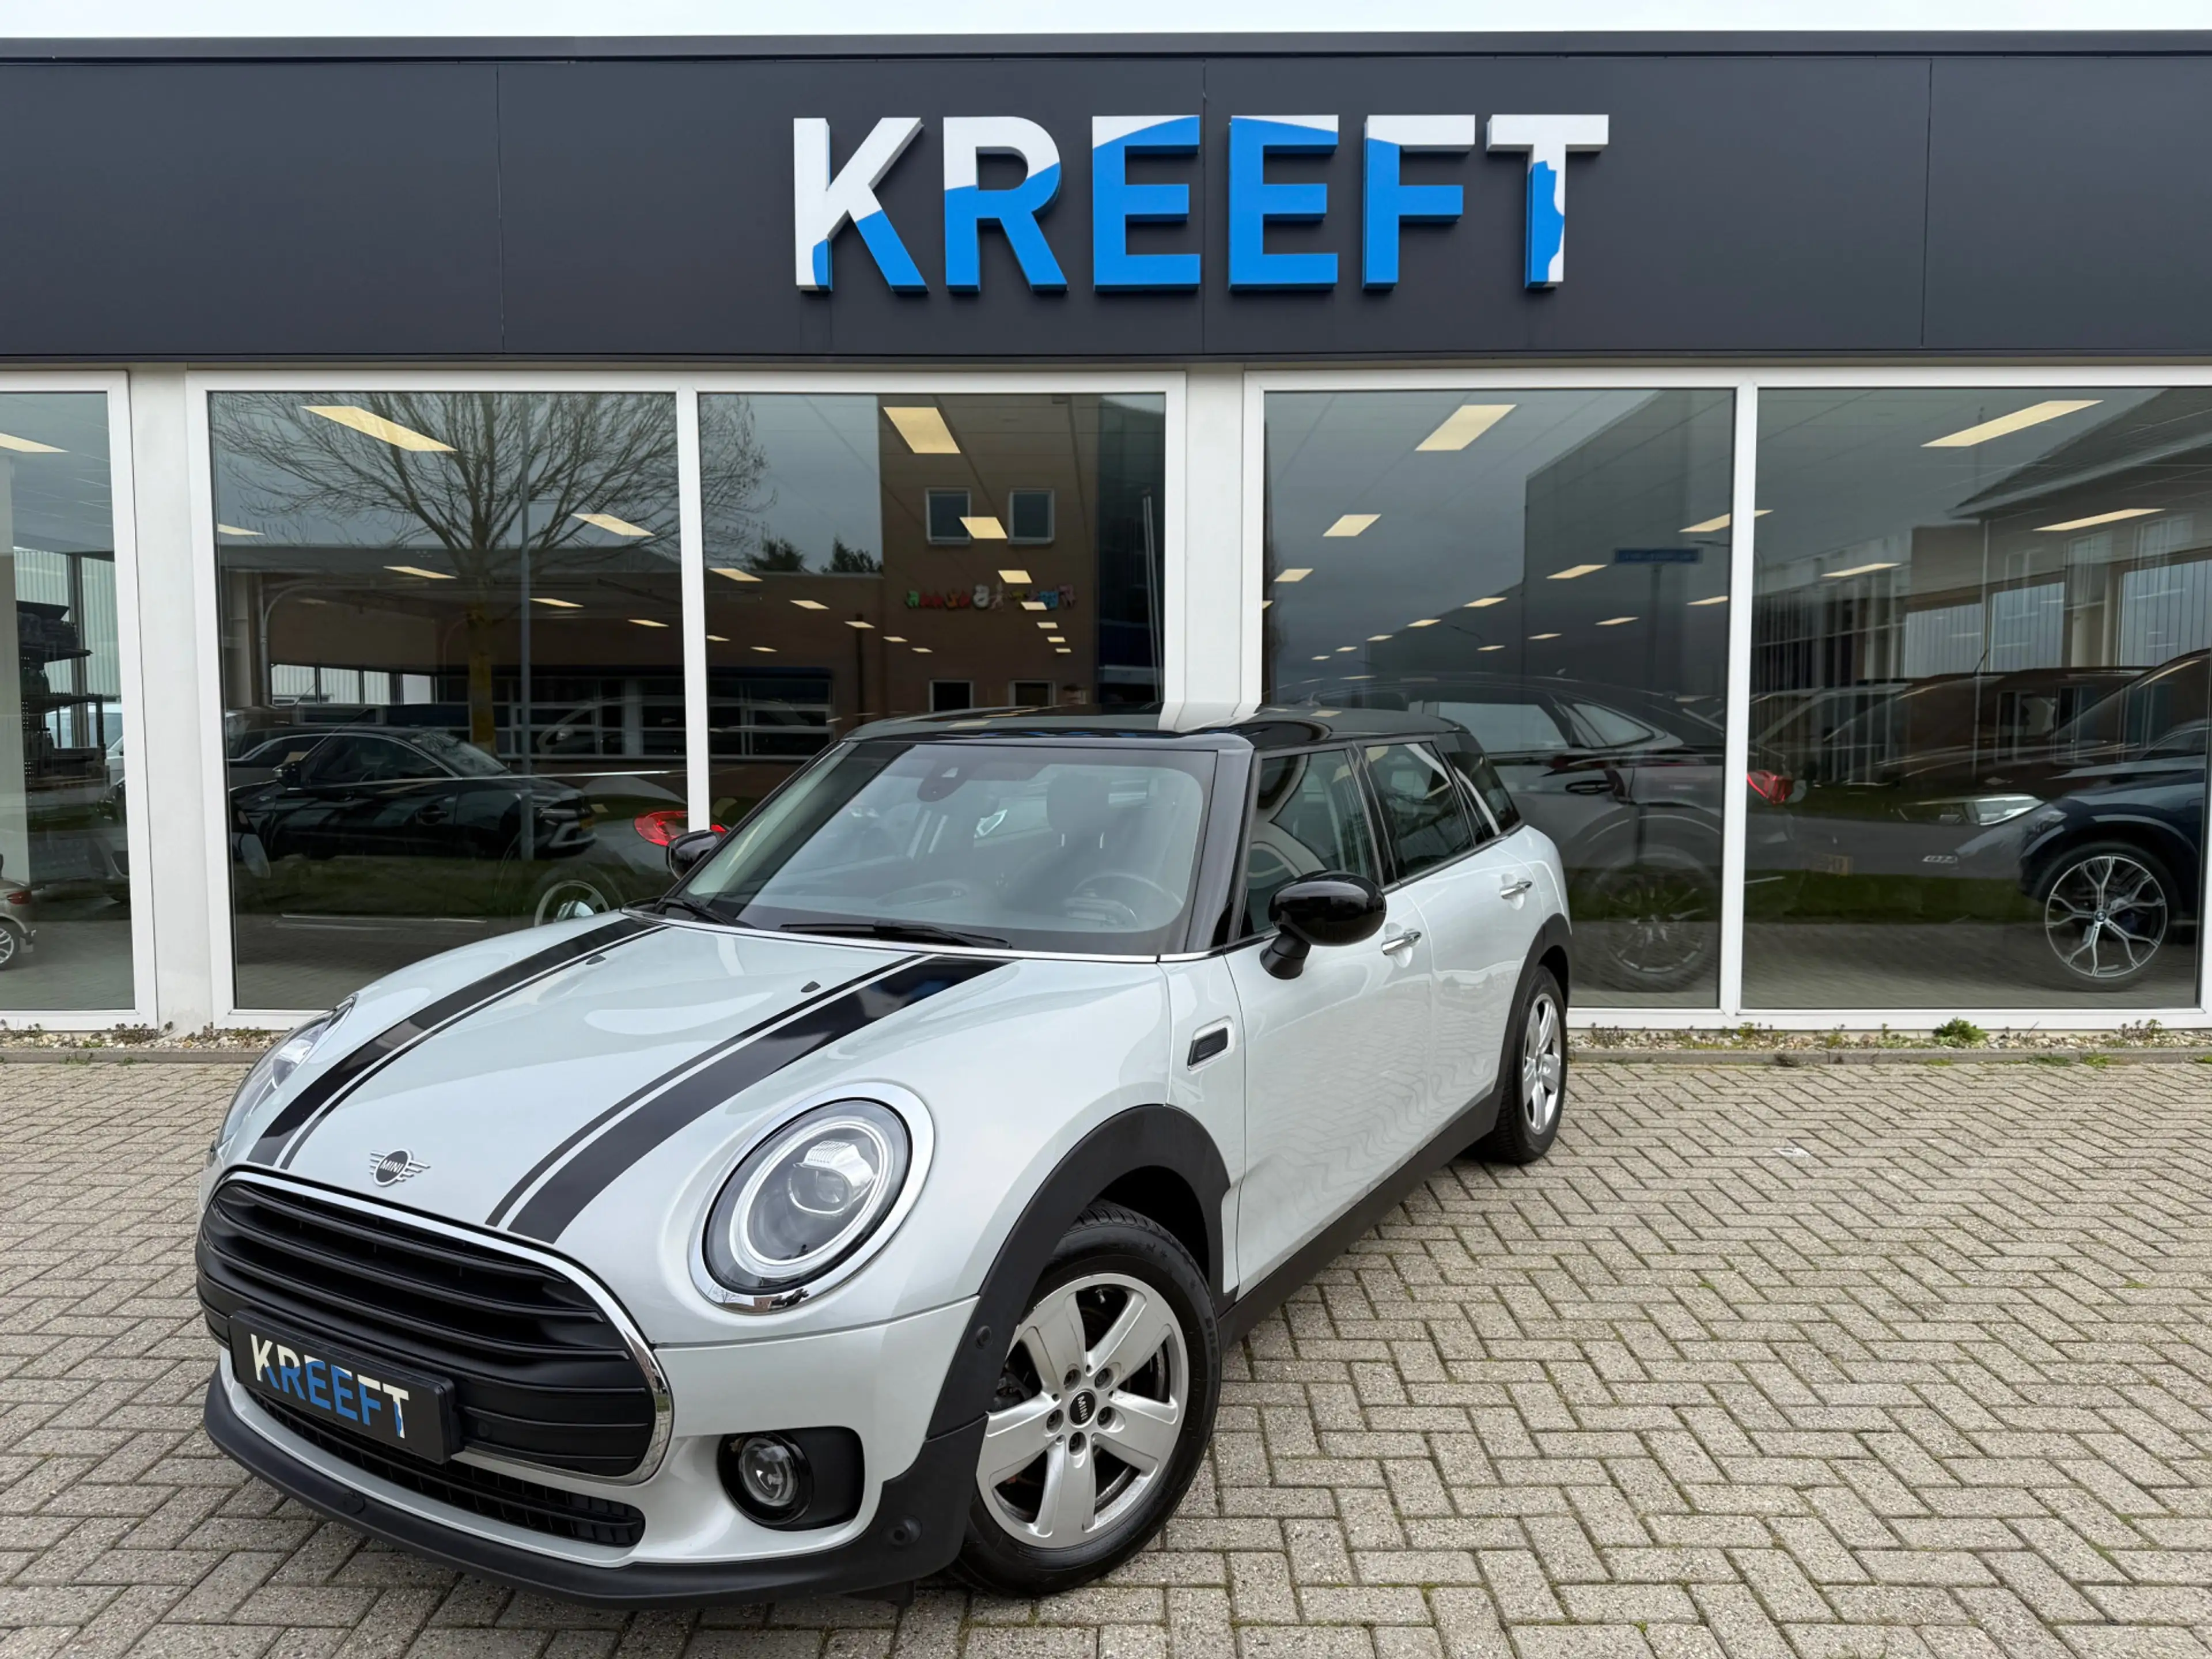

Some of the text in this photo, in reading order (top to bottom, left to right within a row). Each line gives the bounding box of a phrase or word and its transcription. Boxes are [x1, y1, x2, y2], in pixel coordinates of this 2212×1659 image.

[793, 115, 1611, 293] KREEFT
[381, 1160, 404, 1173] MINI
[250, 1334, 408, 1439] KREEFT
[1077, 1395, 1088, 1421] MINI
